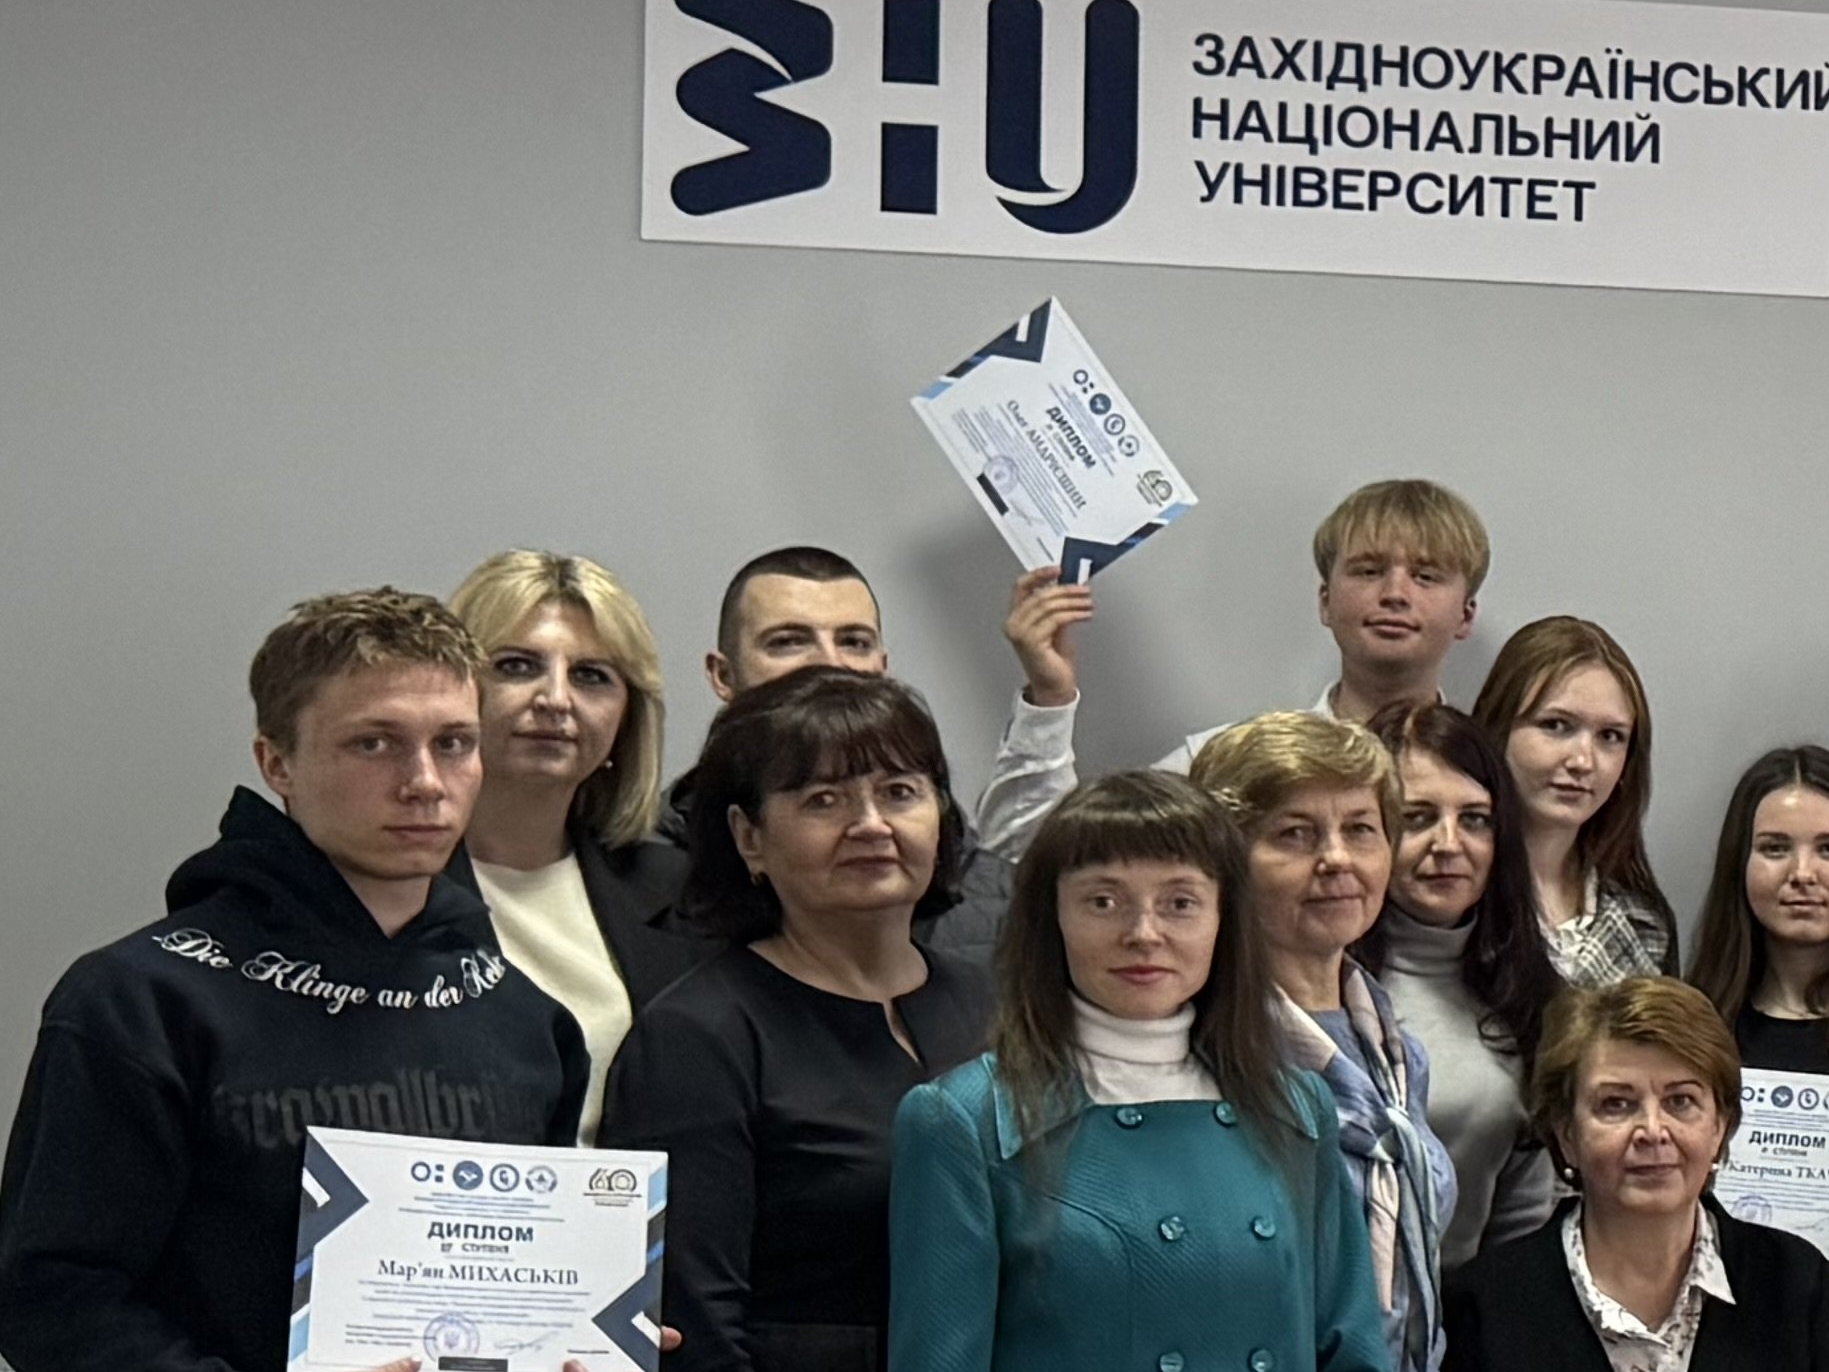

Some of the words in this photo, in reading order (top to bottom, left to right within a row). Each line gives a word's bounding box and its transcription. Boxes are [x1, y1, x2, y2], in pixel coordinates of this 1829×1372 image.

[1192, 96, 1661, 164] НАЦІОНАЛЬНИЙ
[1194, 159, 1597, 223] УНІВЕРСИТЕТ
[152, 928, 233, 968] Die
[241, 951, 369, 1015] Klinge
[377, 990, 418, 1010] an
[424, 975, 463, 1008] der
[1748, 1130, 1827, 1149] ДИПЛОМ
[427, 1221, 534, 1243] ДИПЛОМ
[448, 1264, 579, 1286] МИХАСЬКІВ
